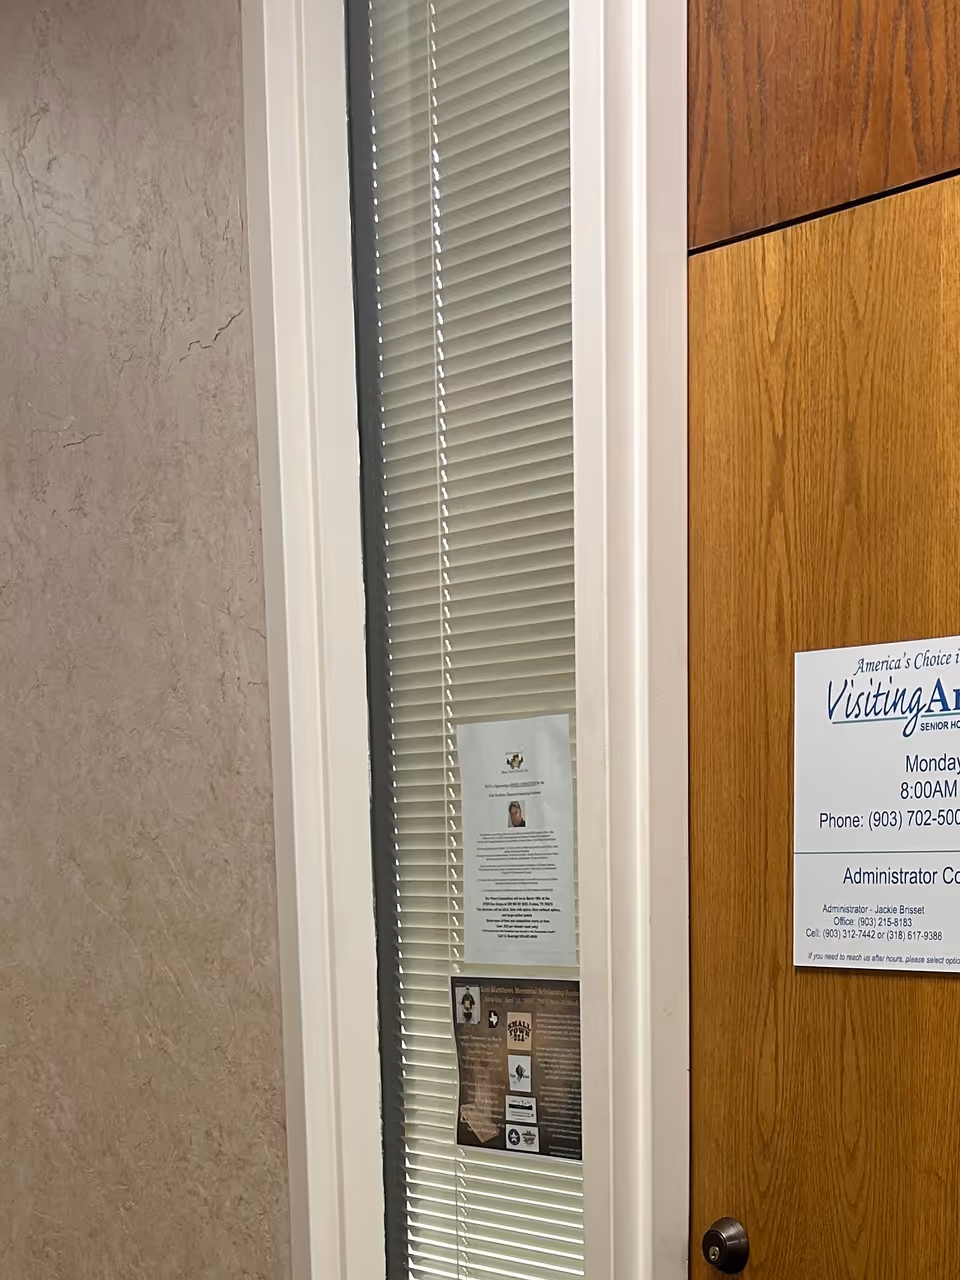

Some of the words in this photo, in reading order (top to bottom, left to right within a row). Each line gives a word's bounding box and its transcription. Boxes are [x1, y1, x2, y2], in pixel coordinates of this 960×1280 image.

[853, 651, 911, 675] America's
[914, 649, 951, 669] Choice
[828, 675, 927, 737] Visiting
[920, 721, 949, 731] SENIOR
[900, 779, 958, 800] 8:00AM
[819, 812, 864, 829] Phone:
[868, 810, 903, 831] (903)
[843, 866, 938, 885] Administrator
[822, 904, 868, 914] Administrator
[874, 904, 898, 914] Jackie
[833, 916, 856, 926] Office:
[857, 917, 877, 928] (903)
[878, 917, 912, 927] 215-8183
[822, 929, 841, 940] (903)
[842, 930, 876, 939] 312-7442
[886, 931, 906, 942] (318)
[907, 931, 943, 941] 617-9388
[824, 952, 839, 960] need
[846, 953, 862, 961] reach
[904, 955, 924, 965] please
[926, 956, 944, 964] select
[508, 1020, 531, 1031] SMALL
[509, 1027, 530, 1037] TOWN
